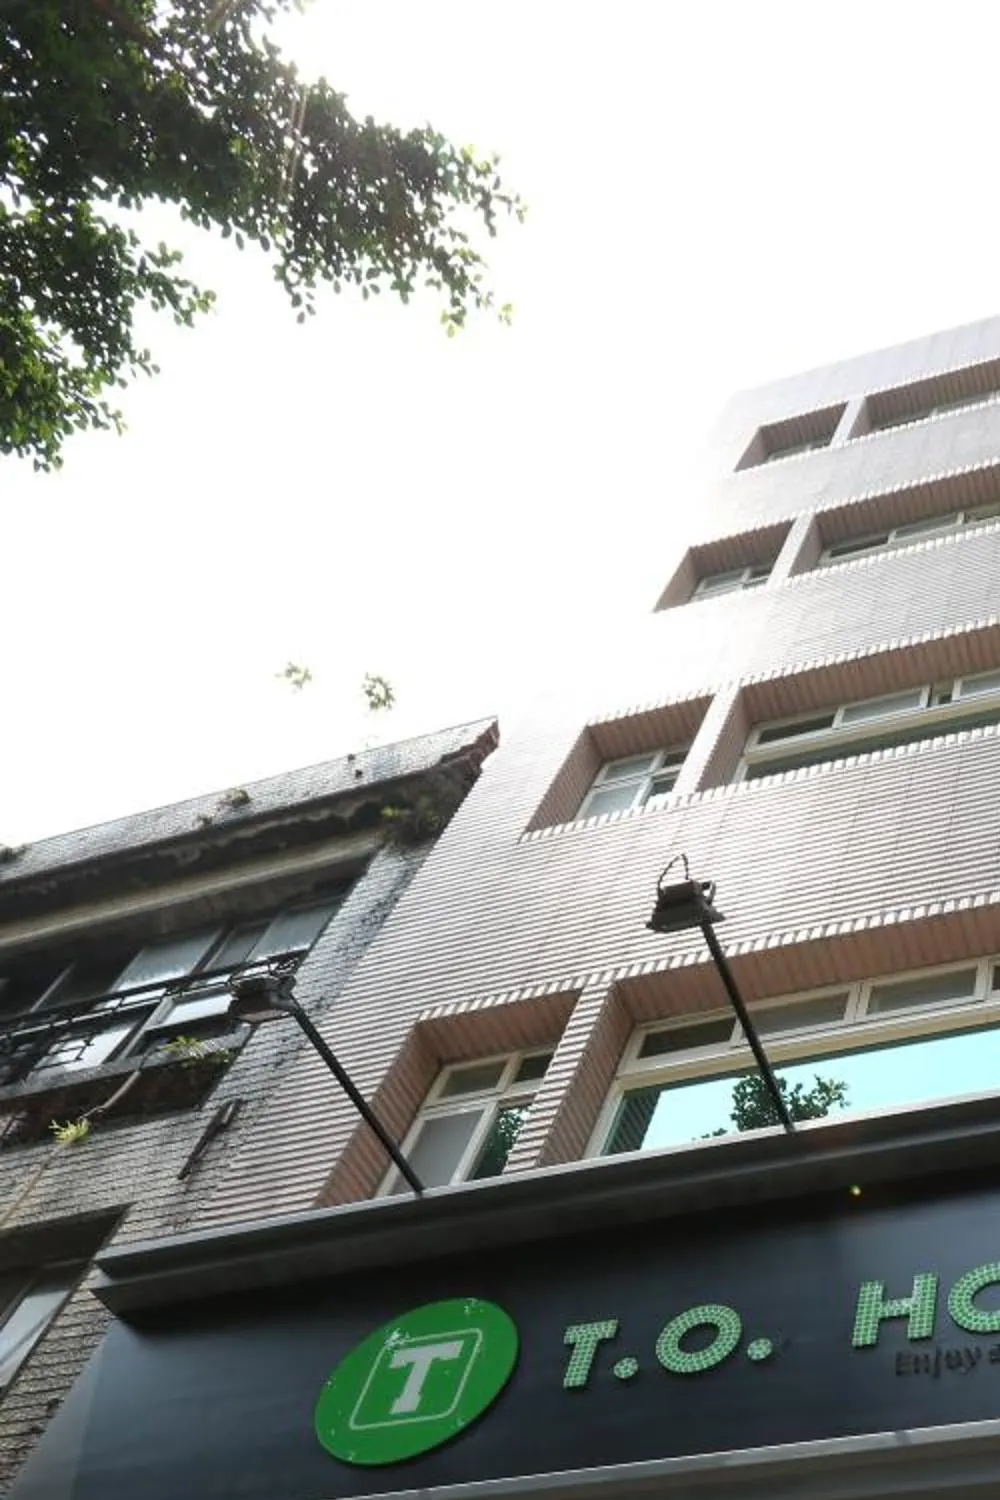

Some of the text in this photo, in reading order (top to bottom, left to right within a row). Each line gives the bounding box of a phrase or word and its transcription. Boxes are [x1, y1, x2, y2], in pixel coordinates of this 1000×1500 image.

[389, 1340, 464, 1415] T
[563, 1304, 773, 1388] T.O.
[895, 1346, 981, 1380] Enjoy
